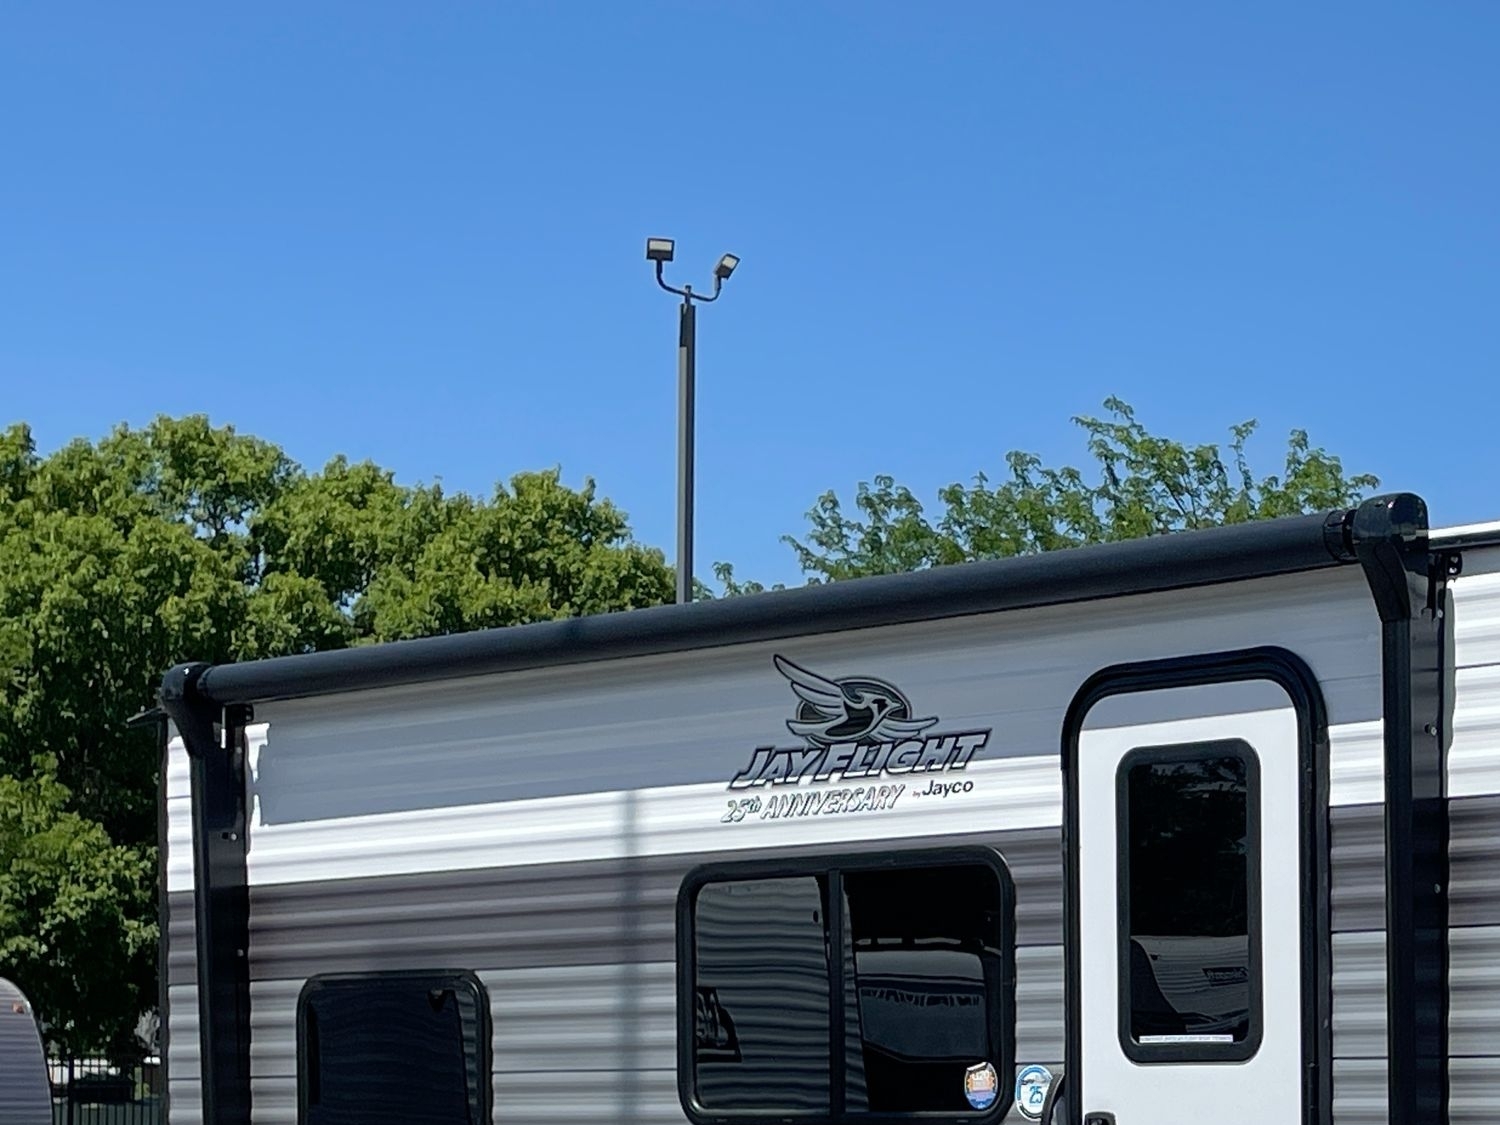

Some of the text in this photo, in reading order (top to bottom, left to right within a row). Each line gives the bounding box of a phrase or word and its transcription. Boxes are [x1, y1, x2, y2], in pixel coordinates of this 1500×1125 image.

[922, 780, 974, 798] Jayco
[720, 784, 905, 823] 25th ANNIVERSARY
